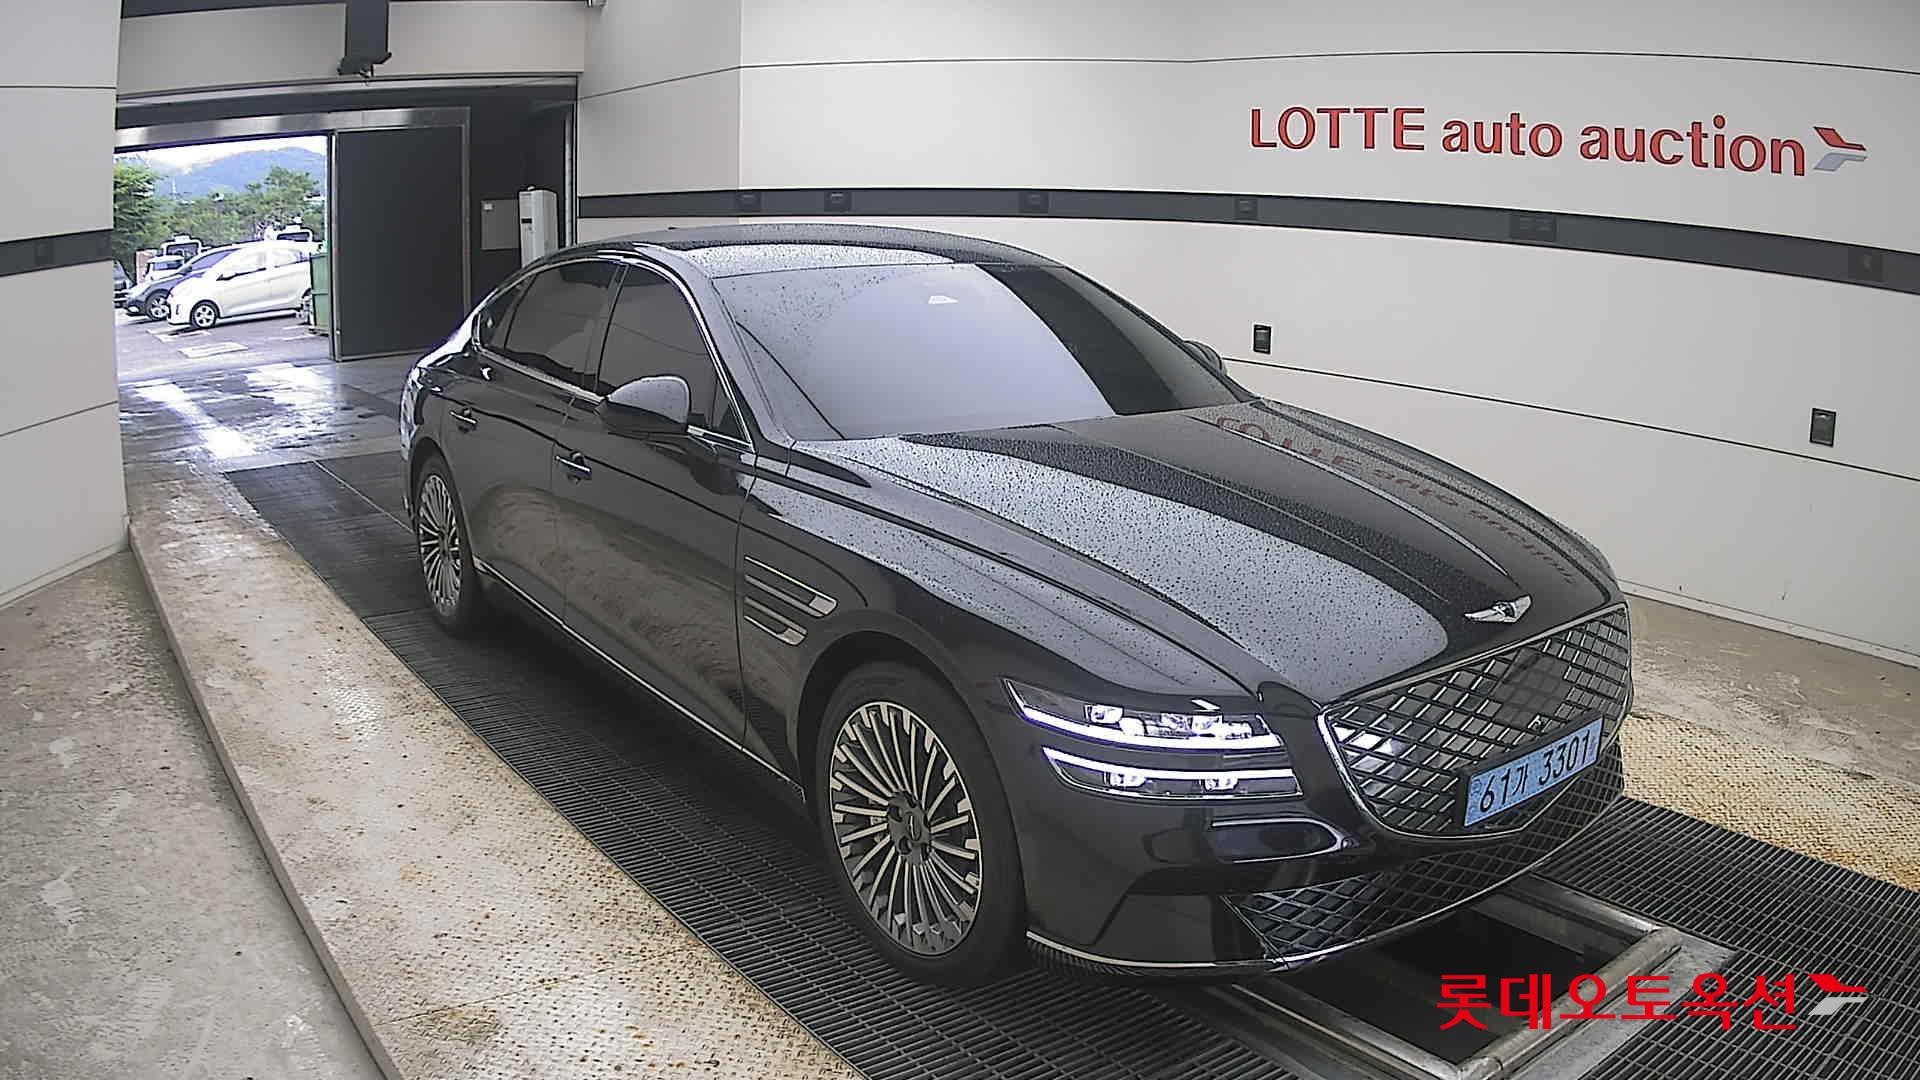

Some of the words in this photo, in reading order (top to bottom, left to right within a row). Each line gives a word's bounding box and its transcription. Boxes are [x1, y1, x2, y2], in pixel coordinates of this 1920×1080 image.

[1251, 107, 1425, 150] LOTTE
[1441, 112, 1563, 157] auto
[1580, 114, 1806, 177] auction
[1480, 763, 1529, 812] 61가
[1538, 729, 1591, 786] 3301
